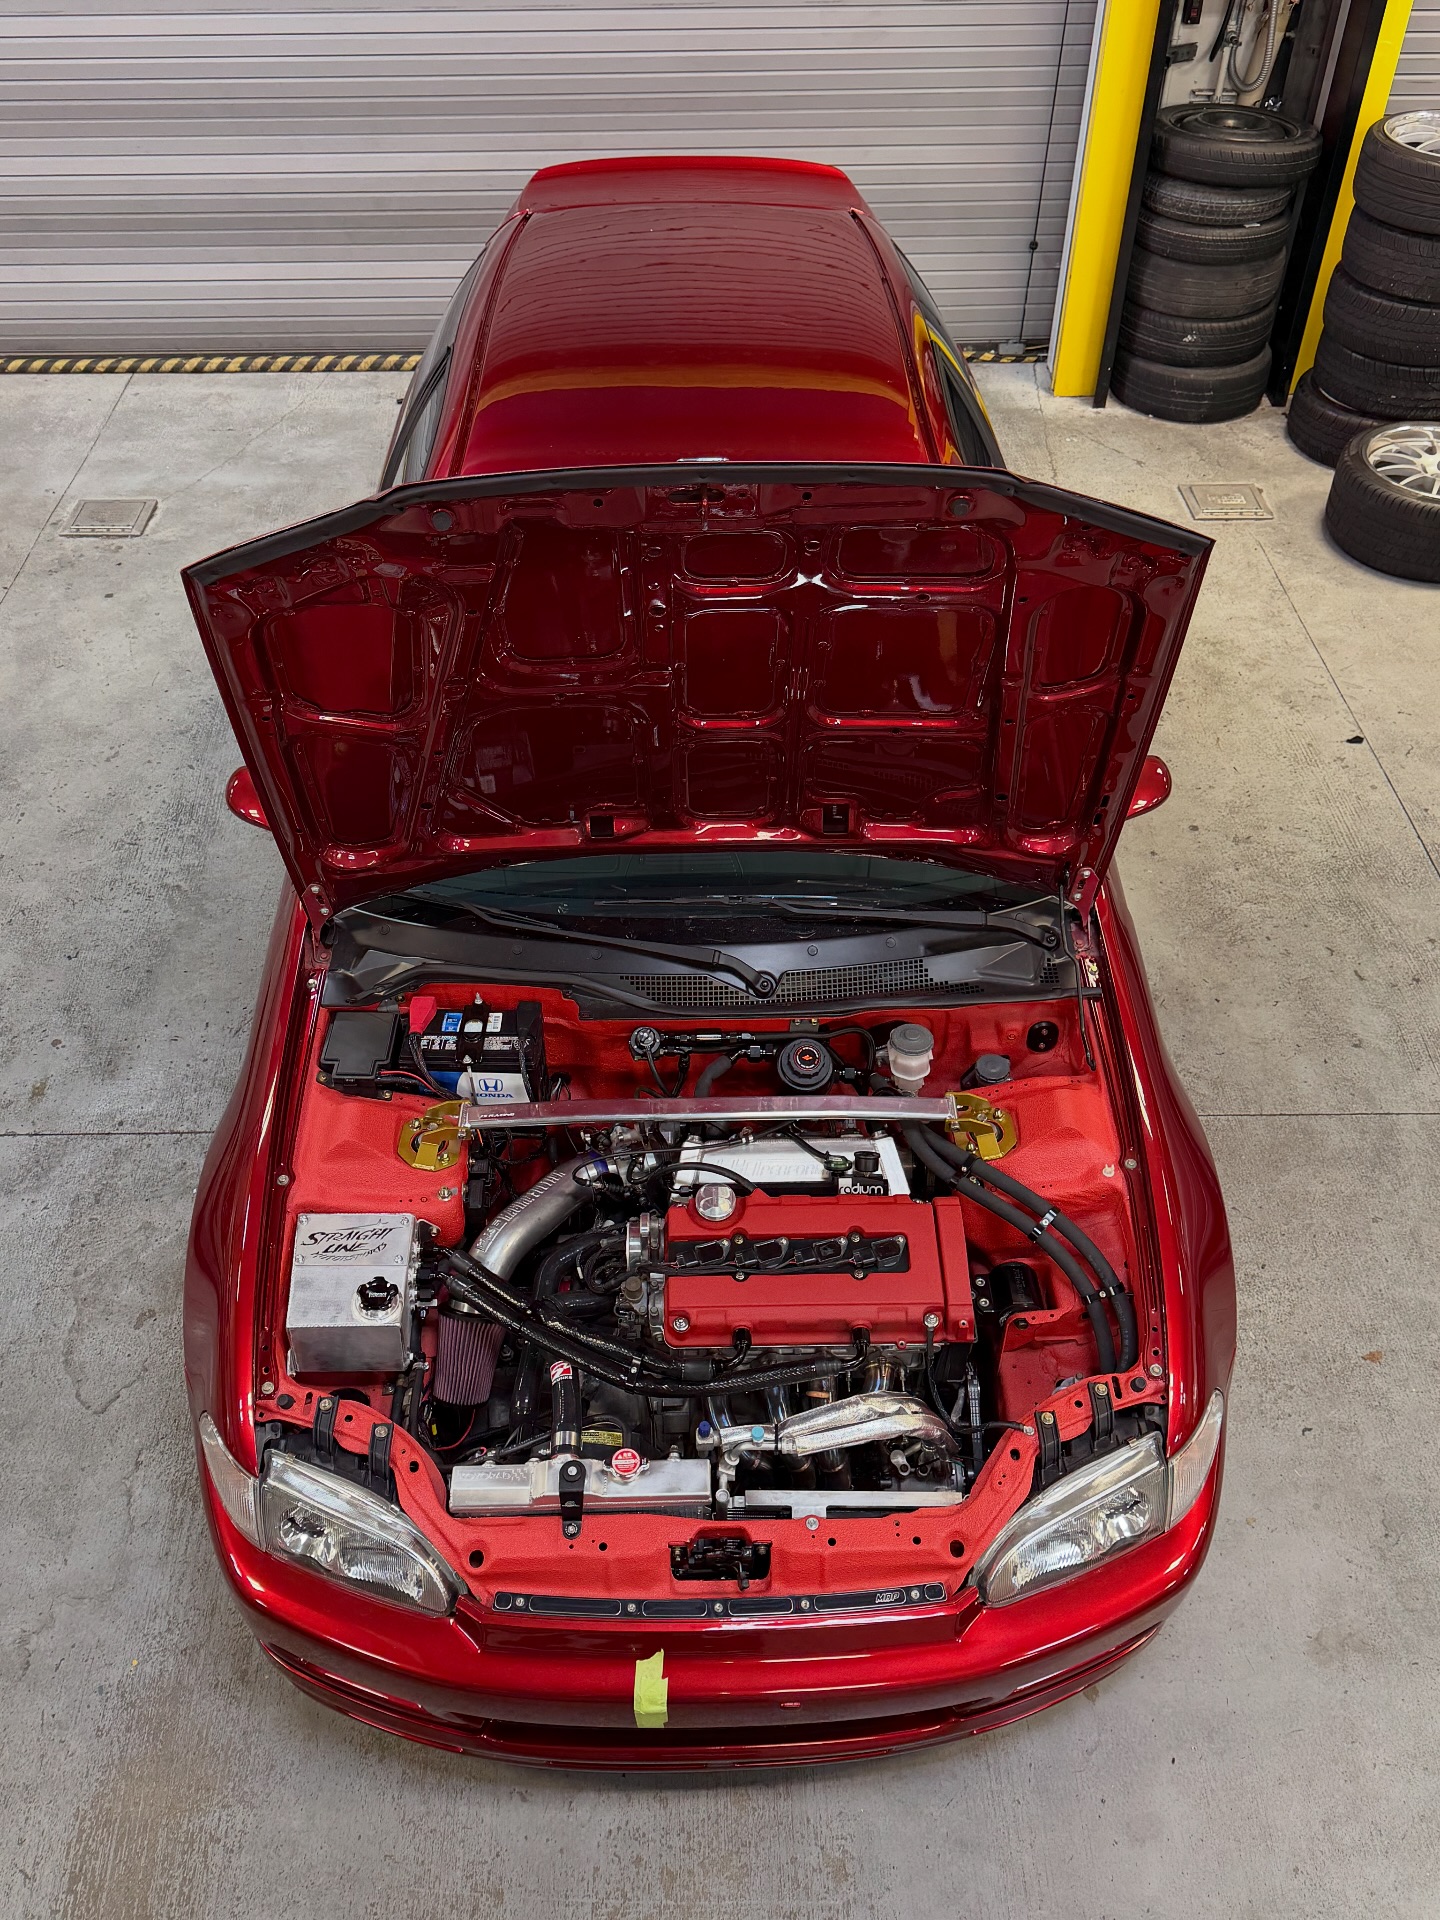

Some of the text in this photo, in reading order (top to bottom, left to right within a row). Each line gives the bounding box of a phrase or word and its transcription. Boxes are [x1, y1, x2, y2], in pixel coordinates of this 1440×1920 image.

[838, 1182, 884, 1195] radium
[300, 1226, 403, 1246] STRAIGHT
[322, 1241, 369, 1254] LINE
